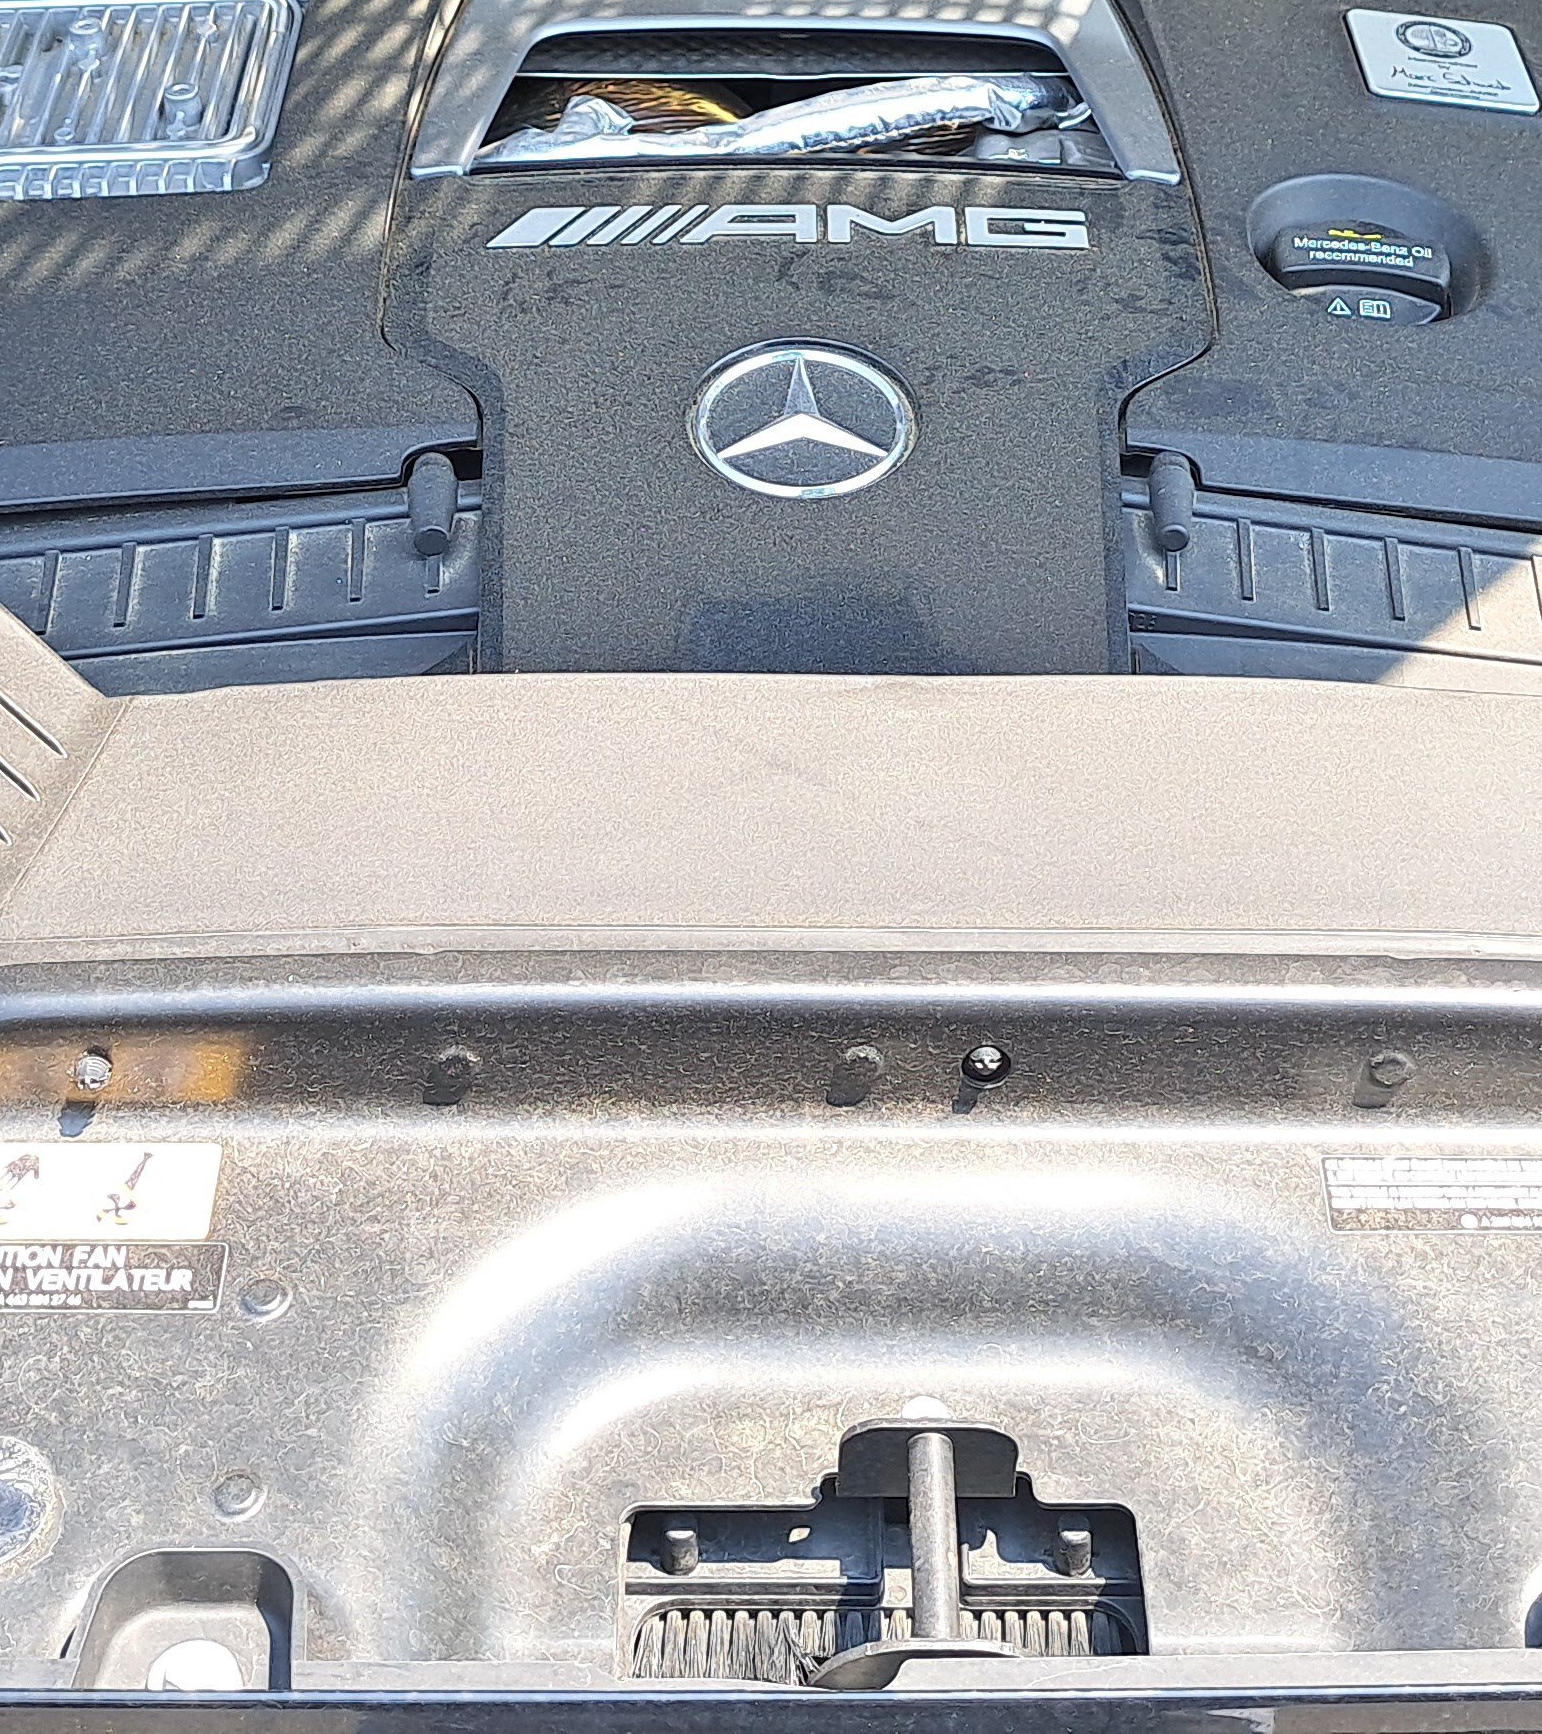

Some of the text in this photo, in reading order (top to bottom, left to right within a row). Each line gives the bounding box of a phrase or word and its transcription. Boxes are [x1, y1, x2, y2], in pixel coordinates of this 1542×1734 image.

[681, 204, 1090, 251] AMG
[1293, 235, 1433, 260] Mercedes-Benz Oil
[1309, 249, 1414, 268] recommended
[72, 1245, 127, 1268] FAN
[25, 1267, 193, 1293] VENTILATEUR
